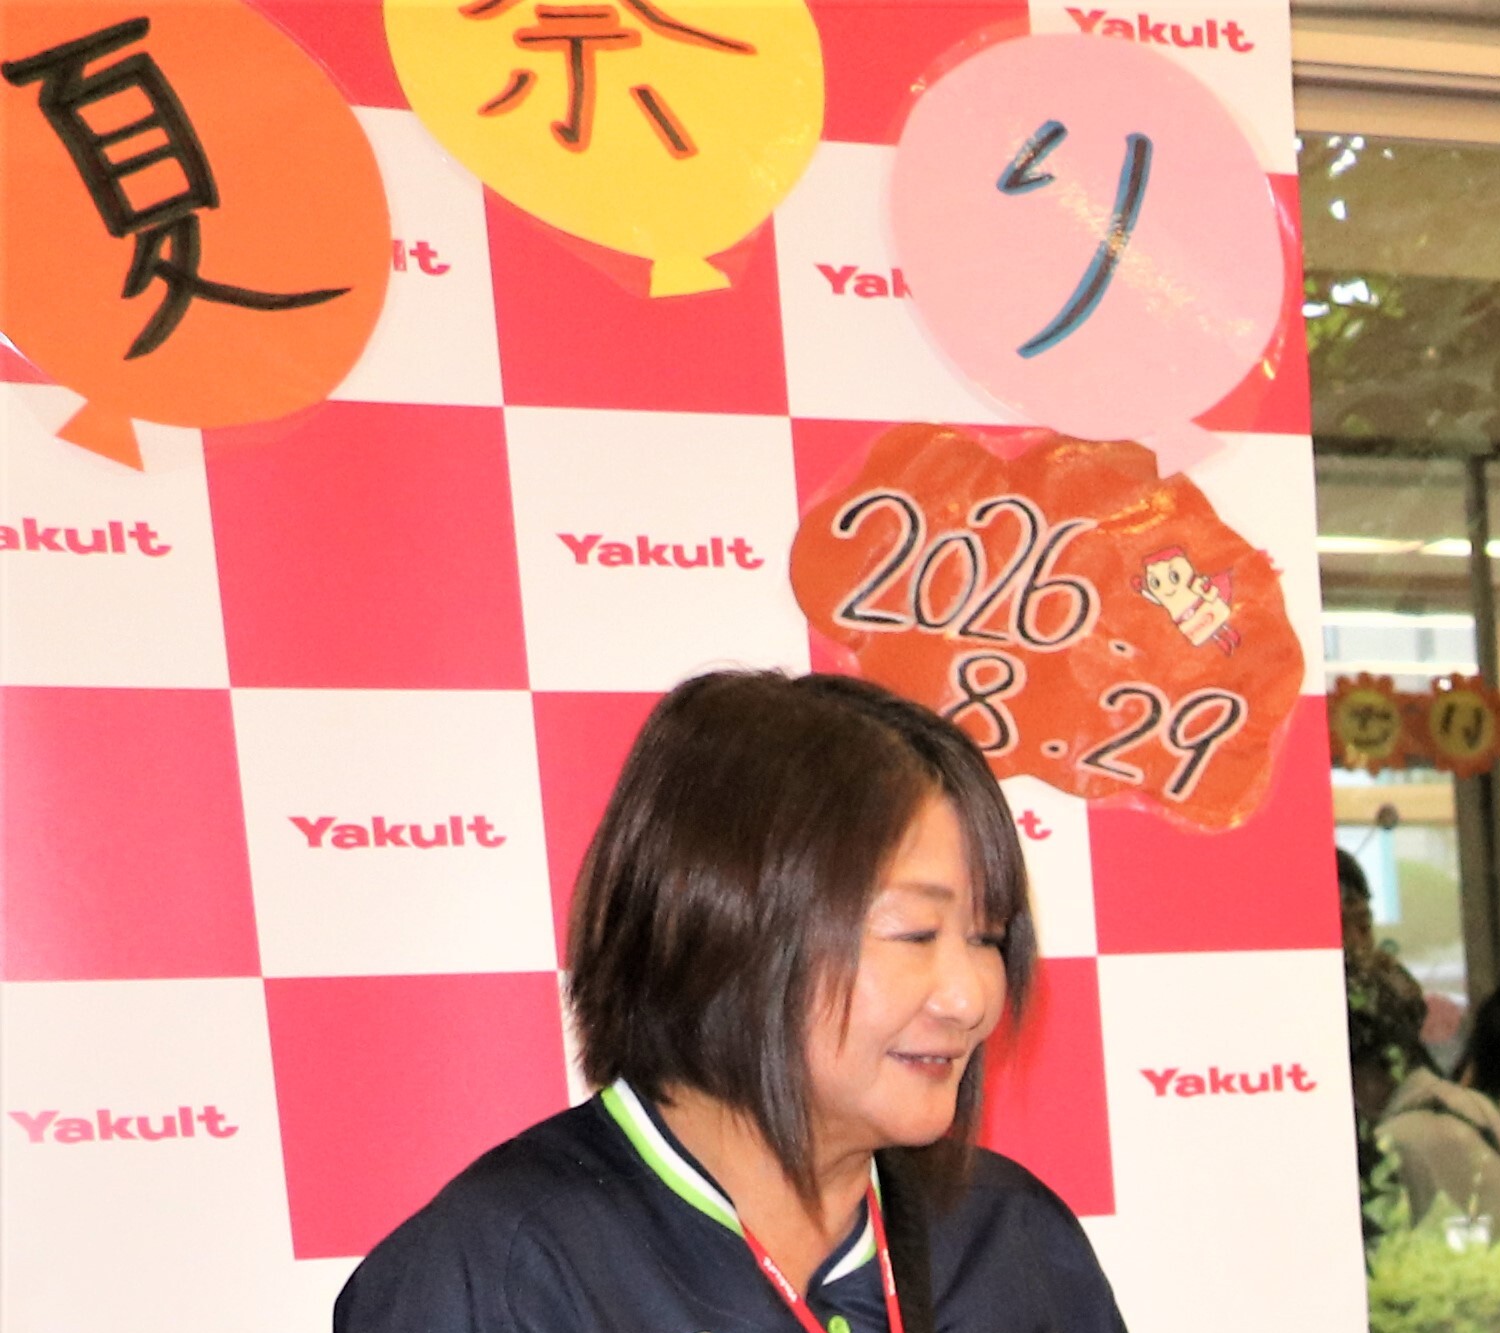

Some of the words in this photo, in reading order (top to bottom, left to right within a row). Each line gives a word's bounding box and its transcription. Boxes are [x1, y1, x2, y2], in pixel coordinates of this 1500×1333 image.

[1, 16, 353, 361] 夏
[0, 517, 173, 558] akult
[556, 532, 765, 571] Yakult
[287, 814, 507, 850] Yakult
[1140, 1062, 1318, 1098] Yakult
[8, 1104, 240, 1145] Yakult
